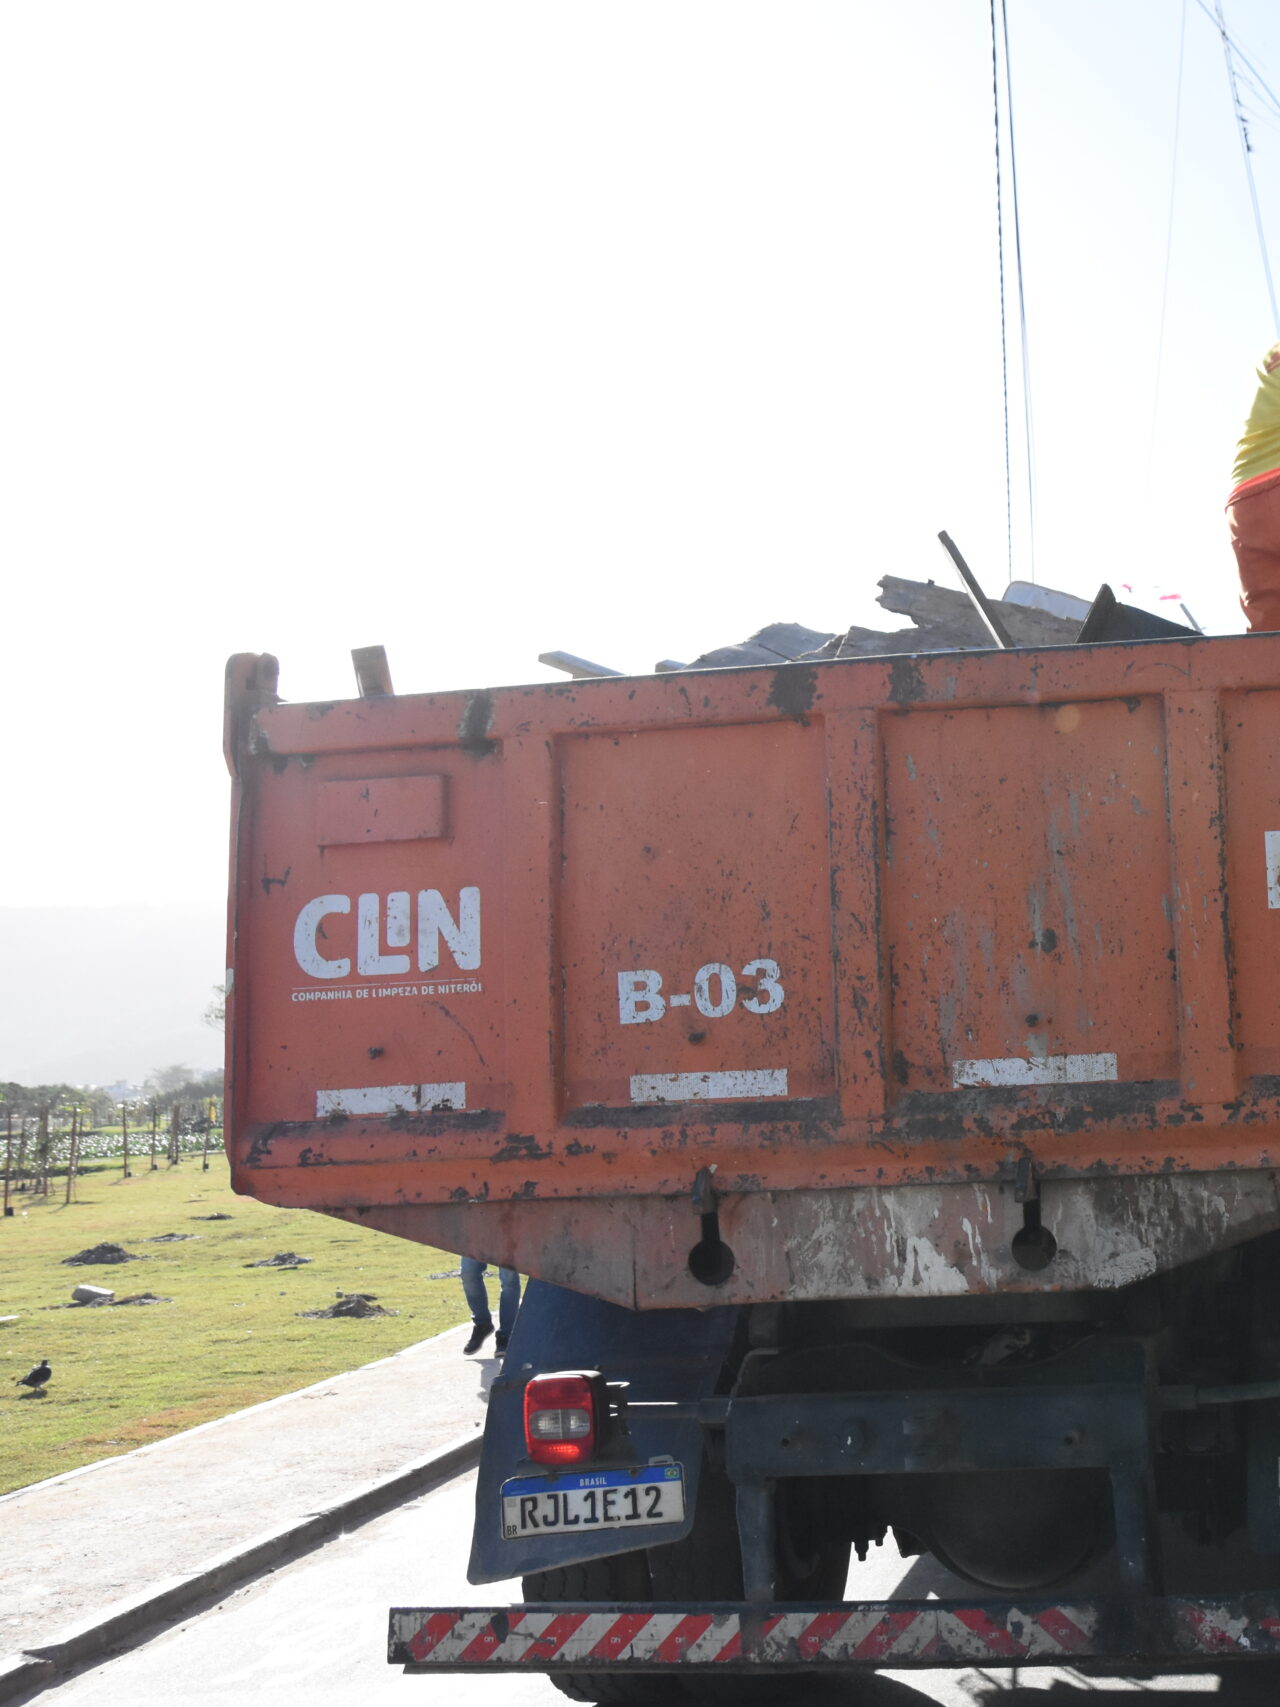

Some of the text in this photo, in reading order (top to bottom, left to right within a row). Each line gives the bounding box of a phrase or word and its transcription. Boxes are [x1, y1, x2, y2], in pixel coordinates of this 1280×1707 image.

[293, 886, 482, 979] CLIN
[291, 981, 482, 1002] COMPANHIA DE LIMPEZA DE NITERÓI
[618, 958, 785, 1025] B-03
[579, 1477, 608, 1487] BRASIL
[520, 1486, 663, 1530] RJL1E12
[506, 1525, 518, 1536] BR
